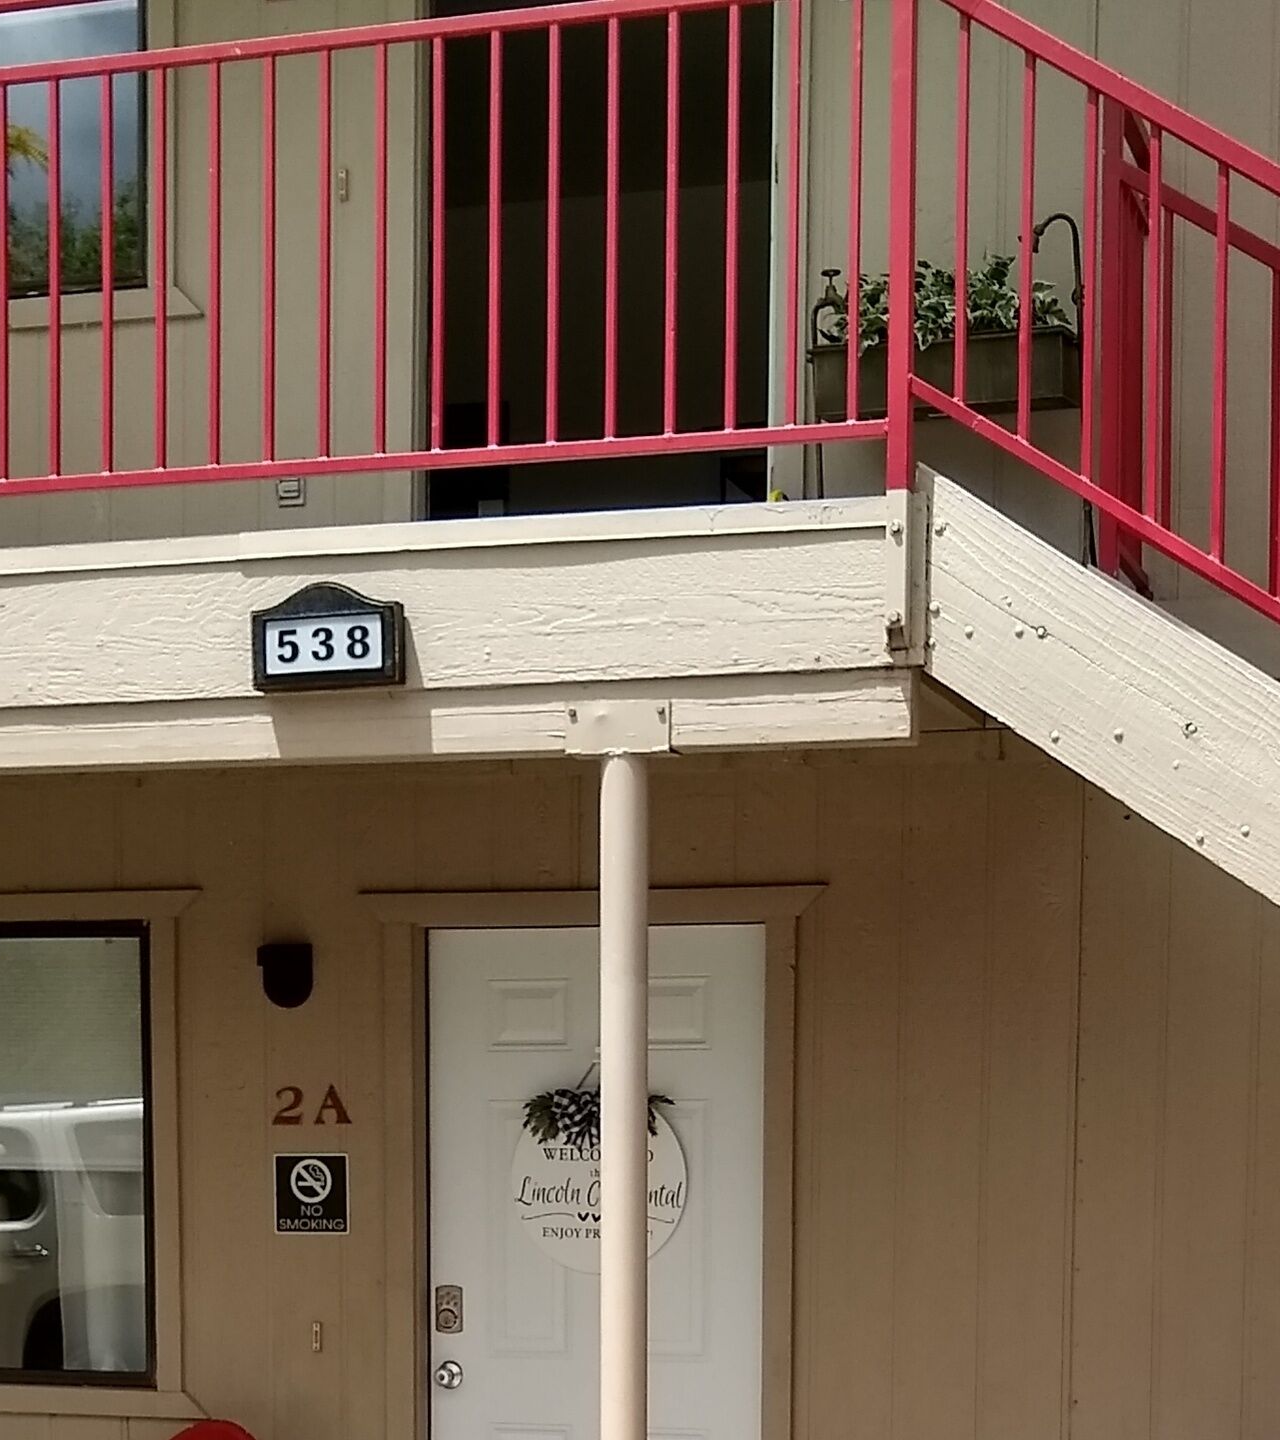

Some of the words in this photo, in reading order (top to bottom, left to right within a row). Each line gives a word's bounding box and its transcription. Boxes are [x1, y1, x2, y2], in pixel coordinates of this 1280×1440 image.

[277, 625, 370, 663] 538
[272, 1083, 353, 1126] 2A
[543, 1147, 601, 1161] WELCO
[515, 1176, 581, 1206] Lincoln
[300, 1204, 323, 1217] NO
[279, 1218, 345, 1230] SMOKING
[542, 1226, 581, 1240] ENJOY
